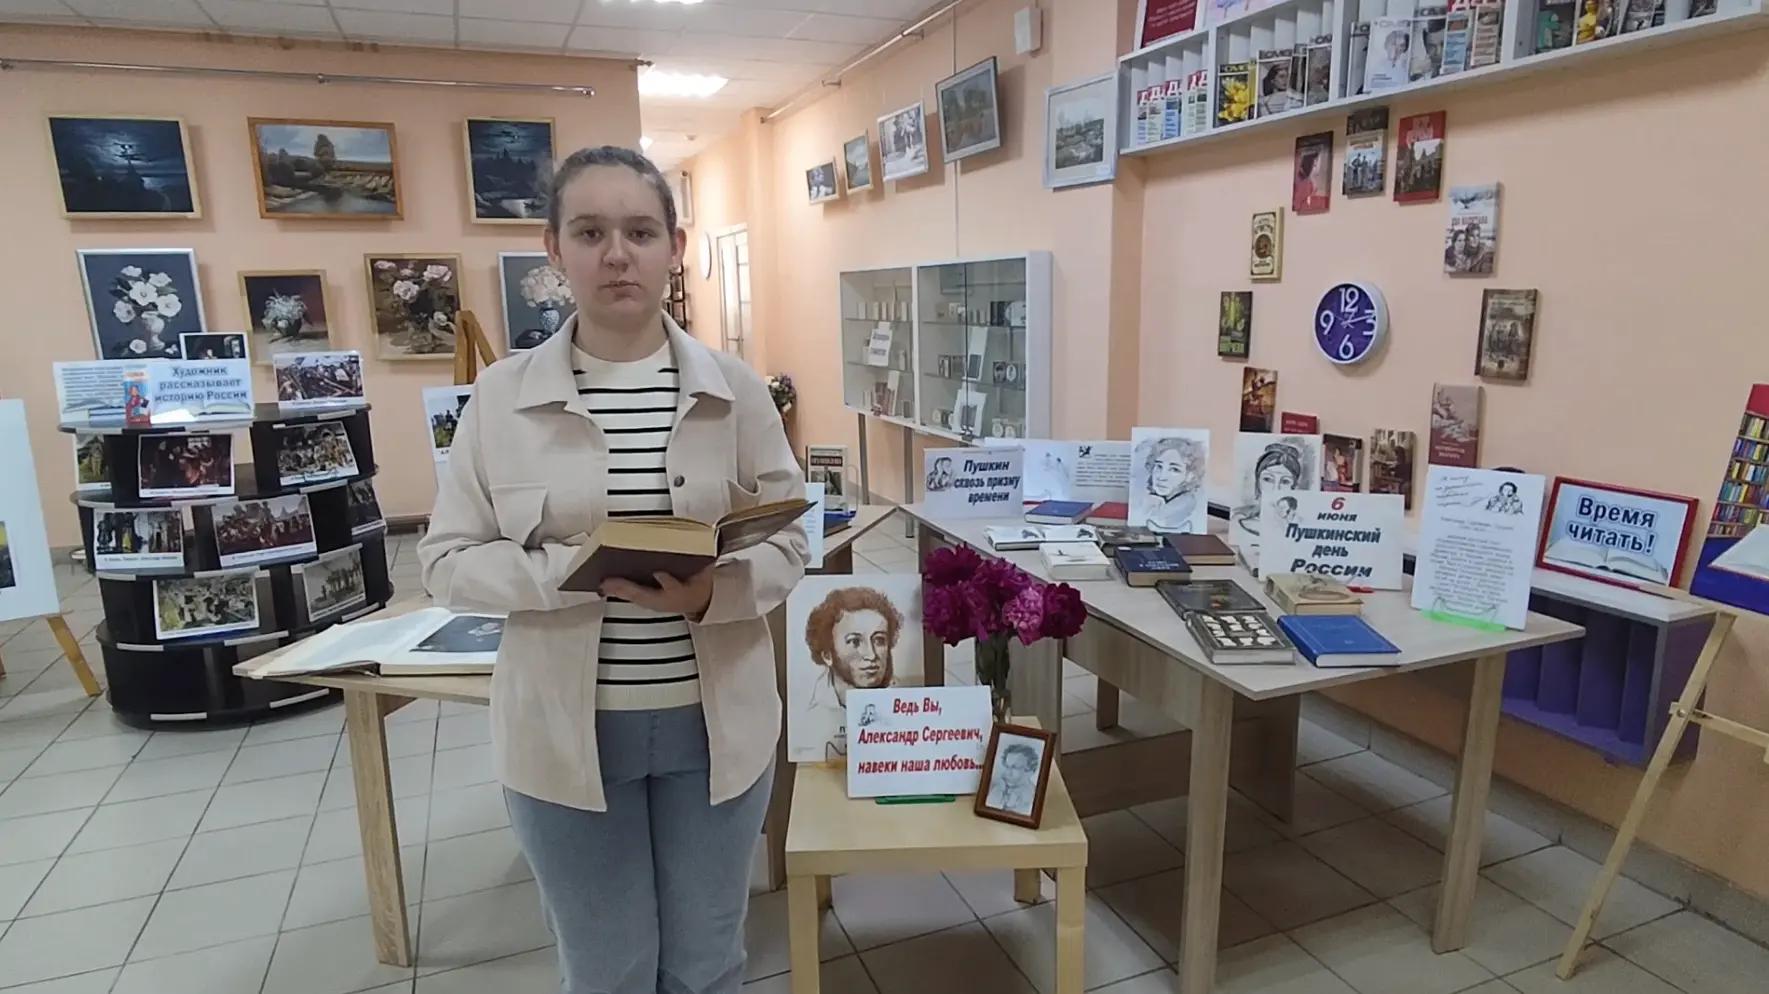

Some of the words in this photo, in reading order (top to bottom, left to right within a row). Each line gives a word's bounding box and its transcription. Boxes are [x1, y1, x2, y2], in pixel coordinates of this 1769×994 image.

[1339, 287, 1359, 312] 12
[1320, 310, 1334, 335] 9
[1339, 334, 1354, 359] 6
[171, 366, 227, 378] Художник
[159, 380, 241, 392] рассказывает
[154, 391, 204, 403] историю
[206, 391, 247, 401] России
[963, 460, 1009, 474] Пушкин
[953, 475, 985, 489] сквозь
[987, 475, 1020, 489] призму
[967, 491, 1009, 506] времени
[1331, 497, 1346, 510] 6
[1317, 512, 1358, 522] июня
[1578, 497, 1655, 528] Время
[1285, 523, 1381, 543] Пушкинский
[1568, 523, 1655, 553] читать!
[1311, 544, 1349, 558] день
[1290, 558, 1373, 577] России
[893, 698, 919, 715] Ведь
[922, 698, 942, 715] Вы,
[858, 728, 919, 746] Александр
[922, 727, 983, 744] Сергеевич,
[858, 760, 897, 774] навеки
[901, 760, 930, 772] наша
